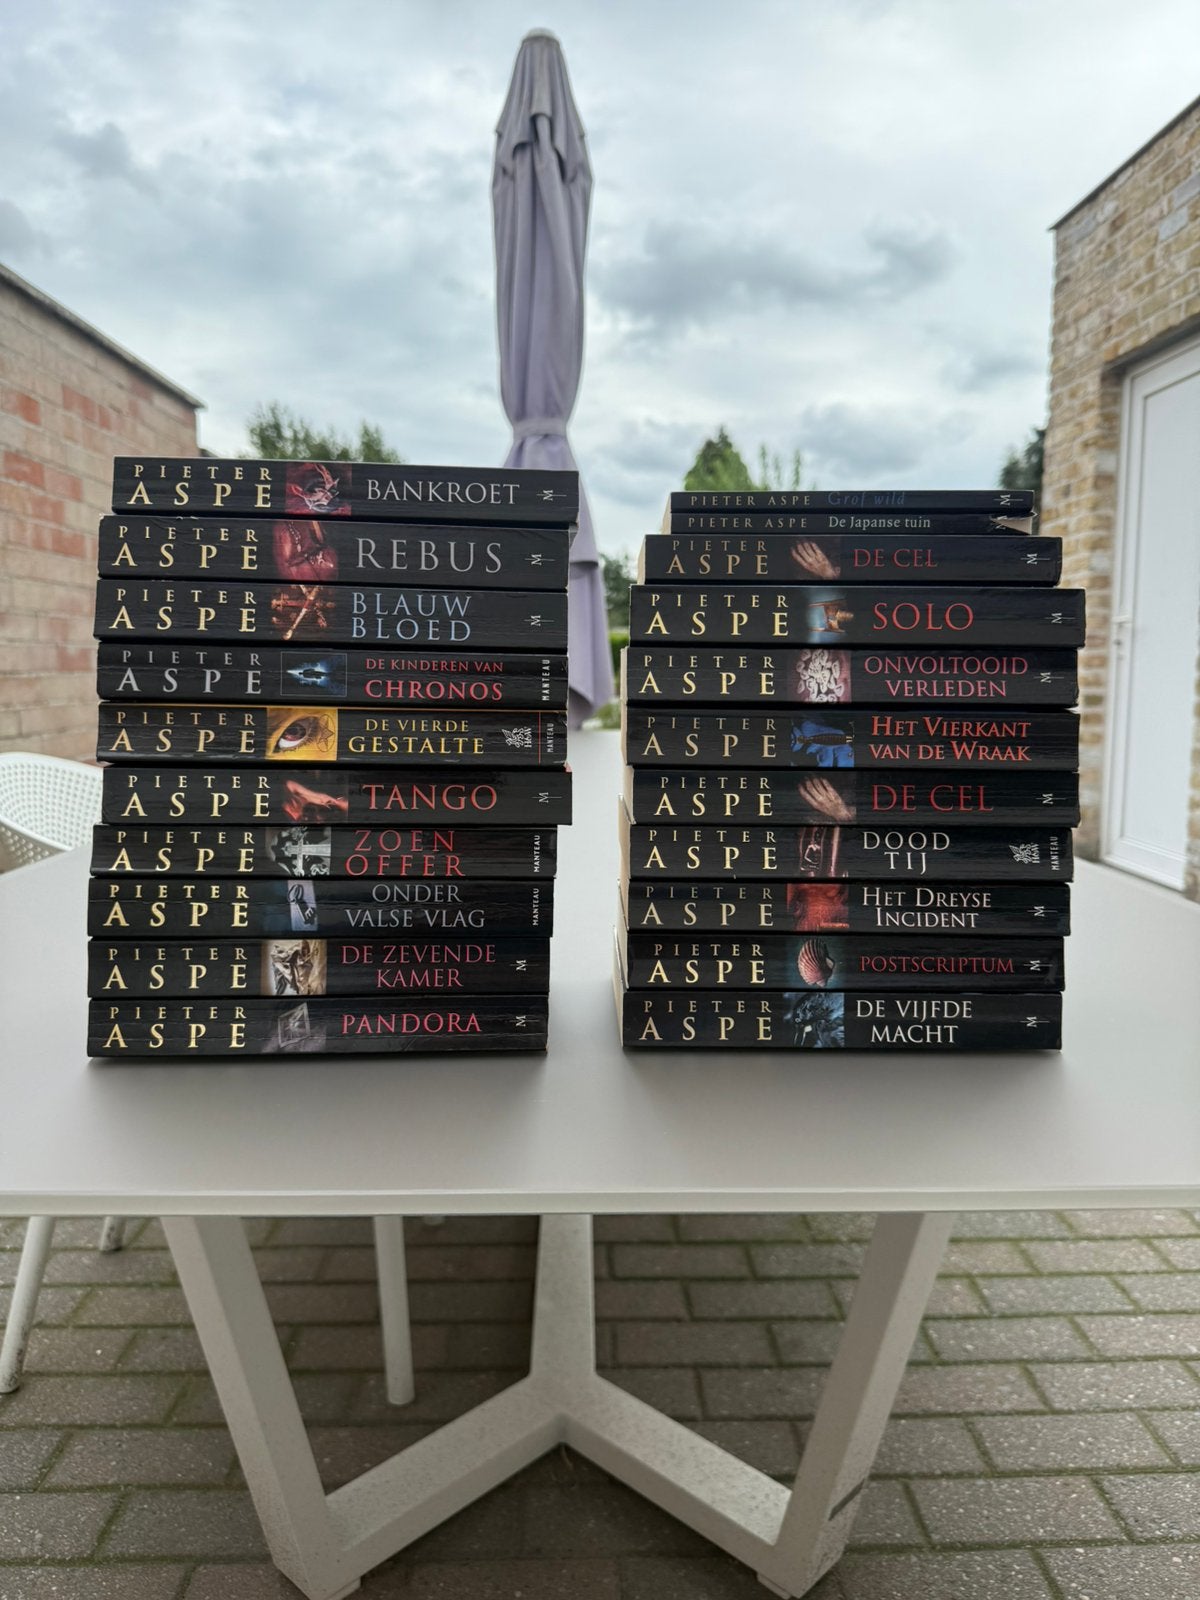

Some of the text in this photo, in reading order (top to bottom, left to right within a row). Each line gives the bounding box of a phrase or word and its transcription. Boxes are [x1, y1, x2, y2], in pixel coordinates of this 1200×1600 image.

[134, 465, 272, 481] PIETER
[127, 481, 272, 508] ASPE
[367, 479, 520, 504] BANKROET
[691, 495, 755, 506] PIETER
[768, 496, 810, 505] ASPE
[874, 492, 906, 505] wild
[688, 516, 931, 530] PIETER ASPE De Japanse tuin
[119, 526, 258, 542] PIETER
[673, 540, 767, 551] PIETER
[112, 543, 258, 570] ASPE
[356, 538, 502, 574] REBUS
[666, 554, 769, 575] ASPE
[854, 549, 938, 567] DE CEL
[117, 588, 256, 605] PIETER
[352, 592, 472, 617] BLAUW
[651, 594, 788, 607] PIETER
[109, 606, 256, 632] ASPE
[645, 611, 789, 636] ASPE
[873, 602, 974, 630] SOLO
[352, 618, 471, 641] BLOED
[122, 651, 262, 666] PIETER
[366, 658, 503, 672] DE KINDEREN VAN
[644, 656, 775, 668] PIETER
[864, 656, 1028, 675] ONVOLTOOID
[116, 667, 262, 694] ASPE
[365, 680, 503, 700] CHRONOS
[542, 659, 550, 701] MANTEAU
[639, 671, 775, 695] ASPE
[885, 680, 1007, 697] VERLEDEN
[117, 712, 255, 726] PIETER
[365, 719, 469, 732] DE VIERDE
[648, 717, 776, 731] PIETER
[872, 716, 1032, 737] HET VIERKANT
[109, 728, 255, 753] ASPE
[349, 737, 485, 754] GESTALTE
[642, 733, 776, 758] ASPE
[869, 741, 1032, 761] VAN DE WRAAK
[128, 775, 271, 789] PIETER
[661, 777, 770, 789] PIETER
[121, 792, 270, 818] ASPE
[362, 784, 497, 811] TANGO
[654, 793, 773, 816] ASPE
[872, 785, 993, 812] DE CEL
[117, 831, 254, 844] PIETER
[354, 830, 455, 852] ZOEN
[649, 830, 776, 842] PIETER
[862, 832, 950, 850] DOOD
[109, 848, 254, 872] ASPE
[644, 846, 777, 870] ASPE
[885, 852, 928, 874] TIJ
[1050, 836, 1059, 870] MANTEAU
[345, 854, 466, 876] OFFER
[110, 884, 249, 898] PIETER
[372, 884, 462, 903] ONDER
[646, 887, 772, 899] PIETER
[862, 887, 991, 908] HET DREYSE
[103, 901, 248, 927] ASPE
[345, 910, 486, 928] VALSE VLAG
[641, 902, 773, 926] ASPE
[876, 908, 979, 928] INCIDENT
[109, 948, 247, 960] PIETER
[342, 944, 496, 964] DE ZEVENDE
[655, 944, 763, 956] PIETER
[648, 960, 766, 983] ASPE
[860, 956, 1014, 973] POSTSCRIPTUM
[102, 965, 247, 990] ASPE
[376, 968, 464, 988] KAMER
[110, 1006, 246, 1020] PIETER
[644, 1000, 772, 1013] PIETER
[856, 1000, 973, 1022] DE VIJFDE
[342, 1012, 482, 1034] PANDORA
[639, 1017, 772, 1041] ASPE
[104, 1023, 246, 1048] ASPE
[871, 1025, 959, 1043] MACHT
